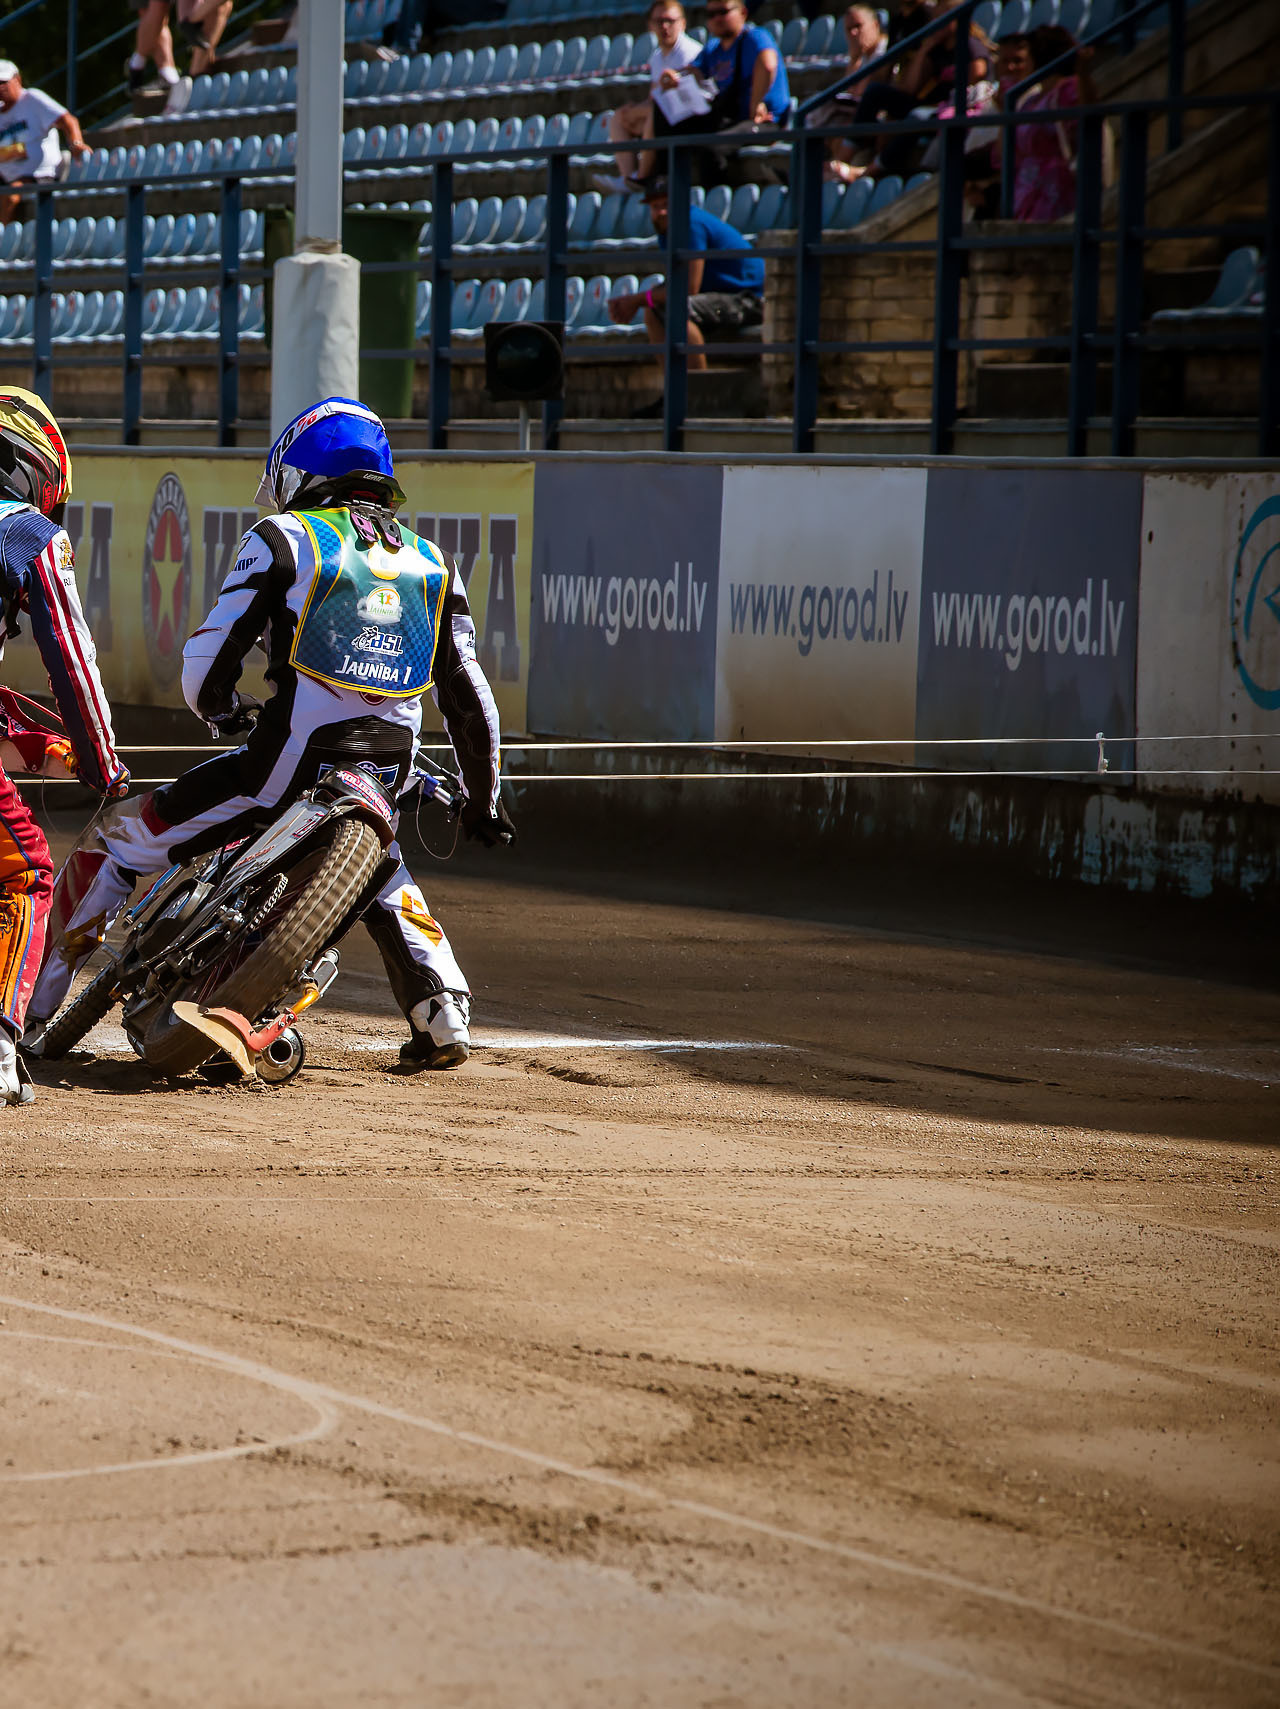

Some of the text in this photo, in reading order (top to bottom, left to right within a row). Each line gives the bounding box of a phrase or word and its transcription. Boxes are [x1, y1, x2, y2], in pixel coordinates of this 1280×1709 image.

[541, 562, 708, 646] www.gorod.lv
[729, 569, 909, 657] www.gorod.lv
[931, 578, 1126, 671] www.gorod.lv
[335, 655, 399, 683] JAUNĪBA
